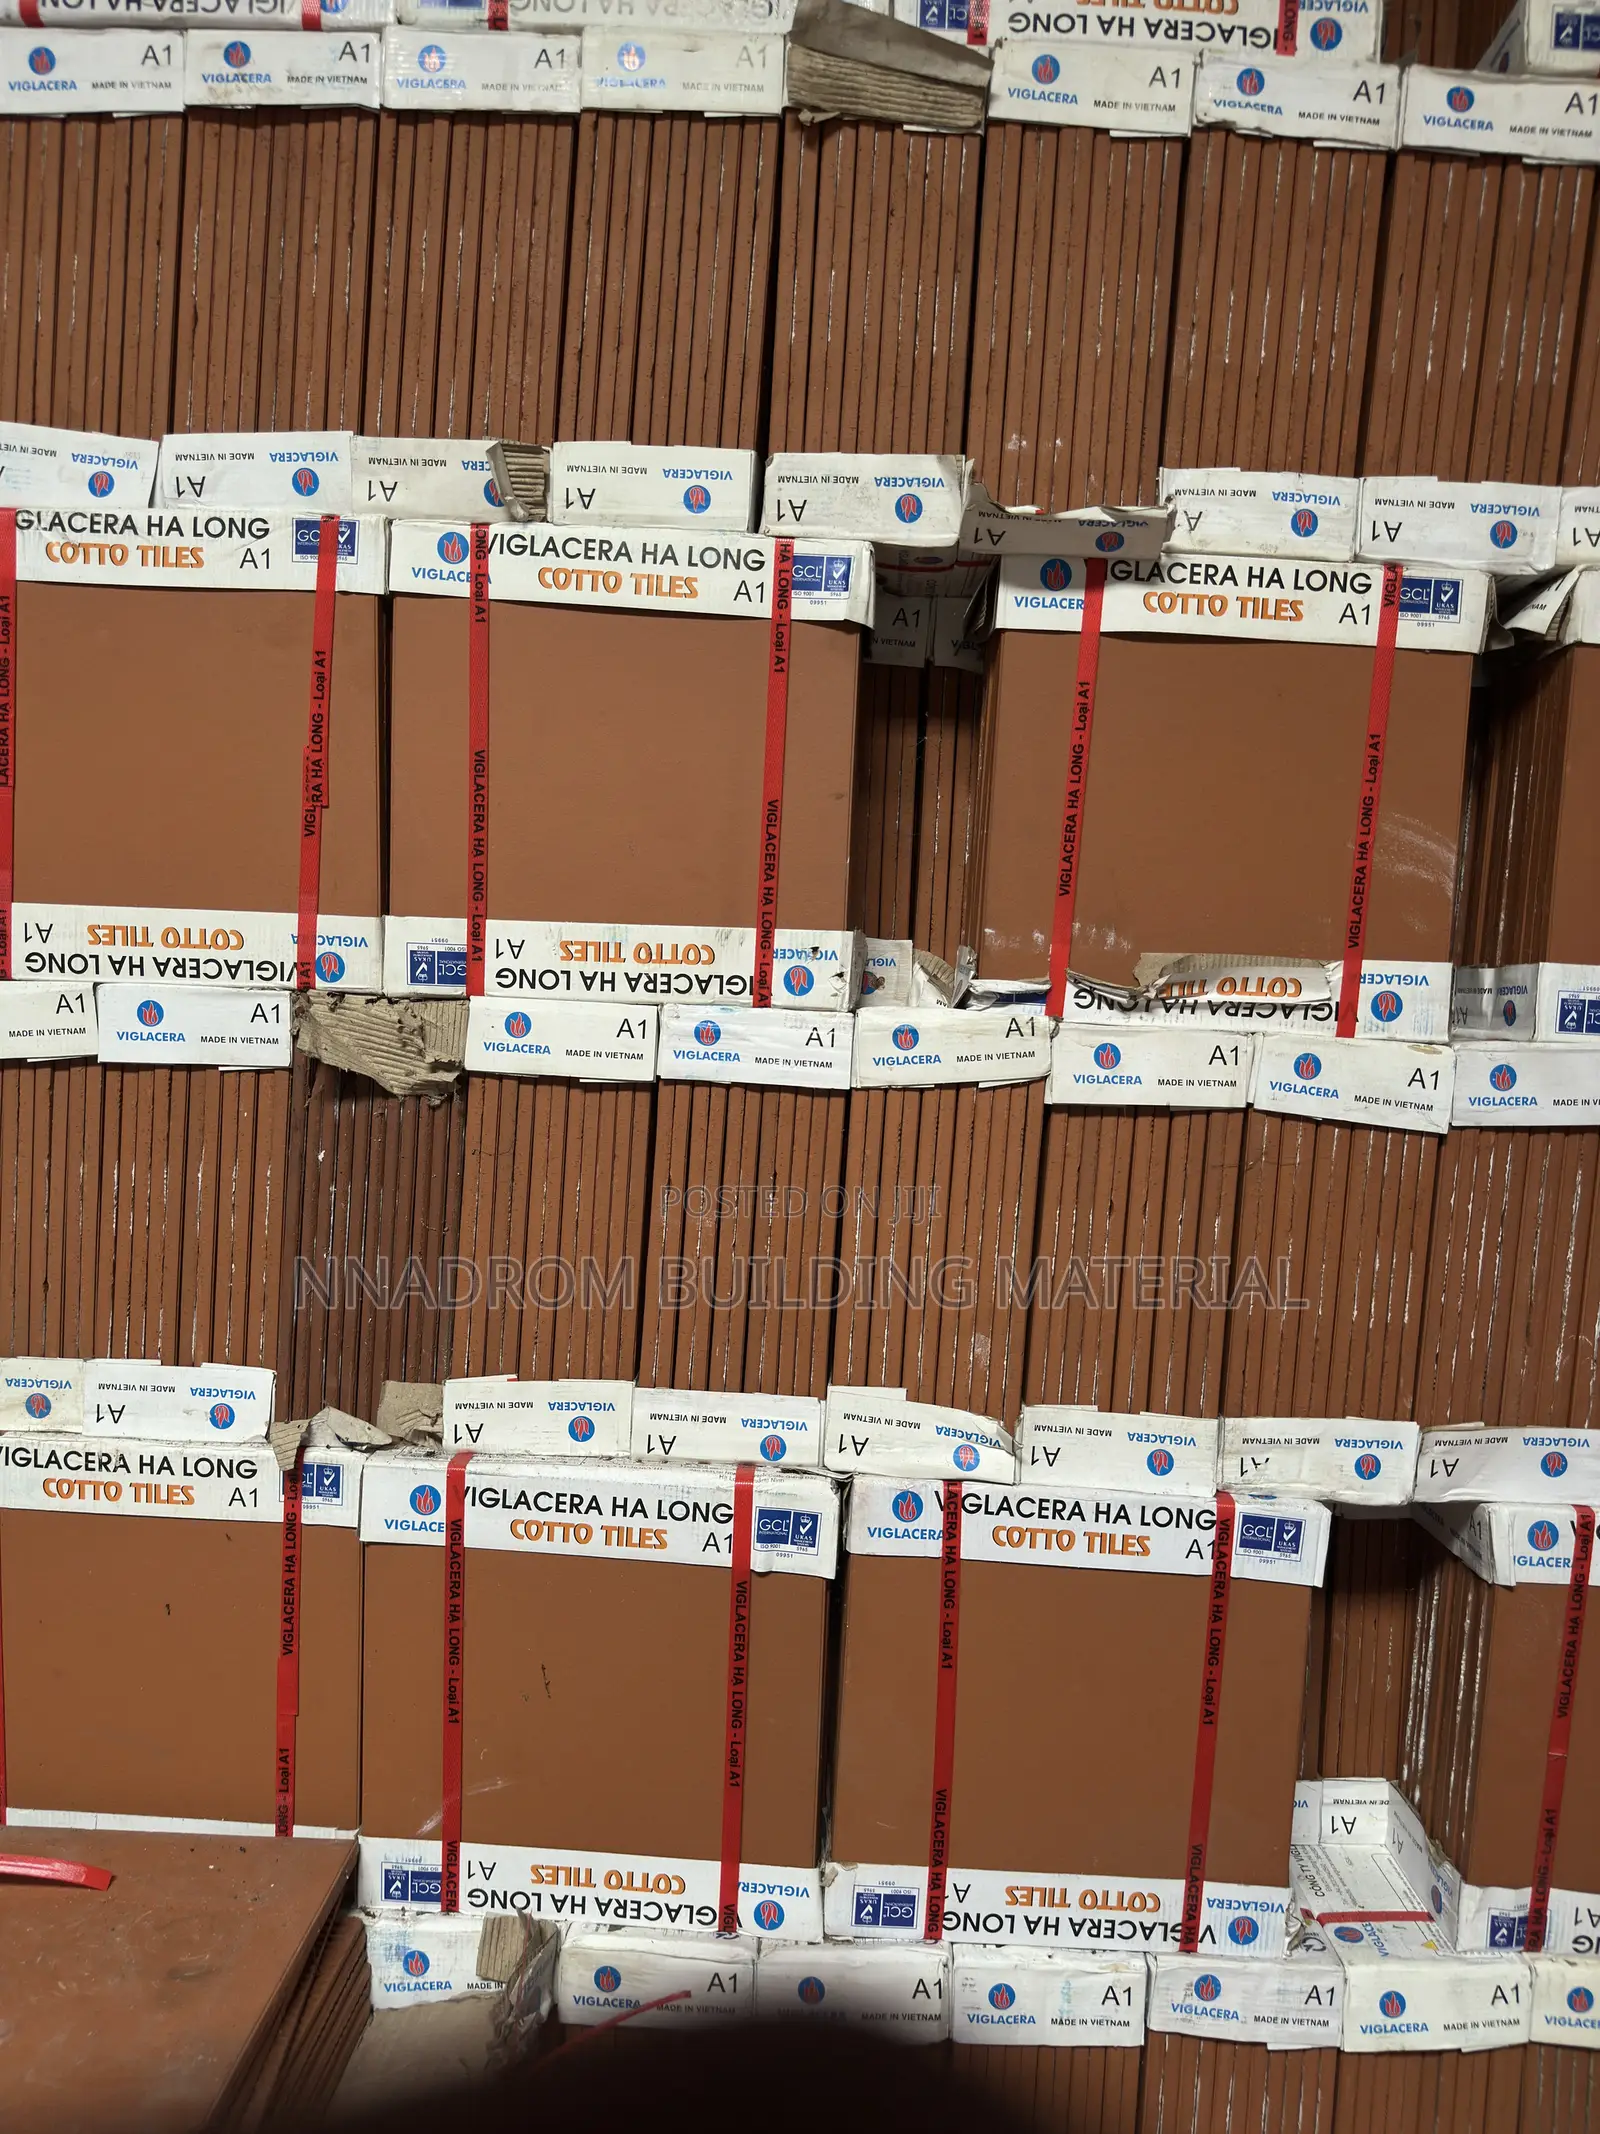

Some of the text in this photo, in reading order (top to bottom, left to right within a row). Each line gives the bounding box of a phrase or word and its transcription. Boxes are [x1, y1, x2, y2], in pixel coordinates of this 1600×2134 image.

[1009, 13, 1277, 49] LONG HA IGLACERA
[142, 45, 170, 65] A1
[8, 79, 78, 92] VIGLACERA
[91, 80, 172, 90] MADE IN VIETNAM
[1149, 67, 1180, 88] A1
[1008, 88, 1077, 104] VIGLACERA
[1093, 99, 1176, 112] MADE IN VIETNAM
[175, 452, 255, 462] MADE IN VIETNAM
[269, 451, 339, 463] VIGLACERA
[176, 476, 205, 497] A1
[1374, 498, 1455, 510] MADE IN VIETNAM
[1470, 503, 1540, 517] VIGLACERA
[16, 510, 269, 539] GLACERA HA LONG
[1372, 521, 1402, 542] A1
[46, 542, 204, 568] COTTO TILES
[240, 548, 269, 569] A1
[642, 543, 678, 565] HA
[688, 546, 765, 571] LONG
[792, 565, 821, 578] GCL
[1105, 559, 1371, 594] IGLACERA HA LONG
[538, 567, 698, 598] COTTO TILES
[734, 580, 764, 603] A1
[1143, 592, 1303, 621] COTTO TILES
[1339, 603, 1370, 625] A1
[473, 750, 486, 833] VIGLACERA
[1059, 814, 1077, 896] VIGLACERA
[1070, 744, 1084, 783] LONG
[1079, 681, 1090, 699] A1
[472, 863, 484, 902] LONG
[25, 923, 53, 943] A1
[88, 925, 244, 950] COTTO TILES
[471, 944, 482, 962] A1
[496, 939, 525, 959] A1
[560, 941, 715, 965] COTTO TILES
[25, 952, 99, 974] LONG
[108, 955, 144, 976] HA
[496, 968, 754, 996] IGLACERA HA LONG
[1217, 977, 1302, 997] COTTO
[251, 1003, 279, 1023] A1
[116, 1031, 186, 1042] VIGLACERA
[617, 1019, 646, 1039] A1
[200, 1035, 279, 1045] MADE IN VIETNAM
[483, 1041, 551, 1055] VIGLACERA
[565, 1049, 644, 1060] MADE IN VIETNAM
[1408, 1068, 1438, 1090] A1
[1270, 1081, 1338, 1098] VIGLACERA
[1354, 1094, 1434, 1112] MADE IN VIETNAM
[455, 1402, 495, 1410] VIETNAM
[508, 1401, 534, 1409] MADE
[547, 1401, 616, 1412] VIGLACERA
[455, 1424, 483, 1444] A1
[1434, 1438, 1472, 1447] VIETNAM
[1484, 1436, 1509, 1445] MADE
[1522, 1436, 1590, 1448] VIGLACERA
[140, 1455, 175, 1475] HA
[183, 1457, 257, 1479] LONG
[1431, 1459, 1459, 1478] A1
[43, 1478, 194, 1505] COTTO TILES
[229, 1488, 257, 1507] A1
[612, 1497, 648, 1518] HA
[657, 1500, 733, 1524] LONG
[1095, 1503, 1131, 1525] HA
[1141, 1504, 1216, 1530] LONG
[510, 1519, 667, 1549] COTTO TILES
[759, 1519, 788, 1531] GCL
[702, 1532, 732, 1553] A1
[992, 1526, 1150, 1556] COTTO TILES
[1186, 1538, 1215, 1559] A1
[1332, 1816, 1356, 1834] A1
[468, 1861, 496, 1880] A1
[531, 1865, 685, 1894] COTTO TILES
[467, 1888, 541, 1910] LONG
[550, 1894, 585, 1914] HA
[1006, 1886, 1160, 1912] COTTO TILES
[1207, 1898, 1284, 1913] VIGLACERA
[943, 1911, 1014, 1934] LONG
[1024, 1915, 1063, 1936] HA
[1305, 1985, 1334, 2006] A1
[1492, 1984, 1519, 2005] A1
[1172, 2003, 1239, 2020] VIGLACERA
[1253, 2015, 1330, 2027] MADE IN VIETNAM
[1359, 2022, 1429, 2035] VIGLACERA
[1443, 2018, 1521, 2031] MADE IN VIETNAM
